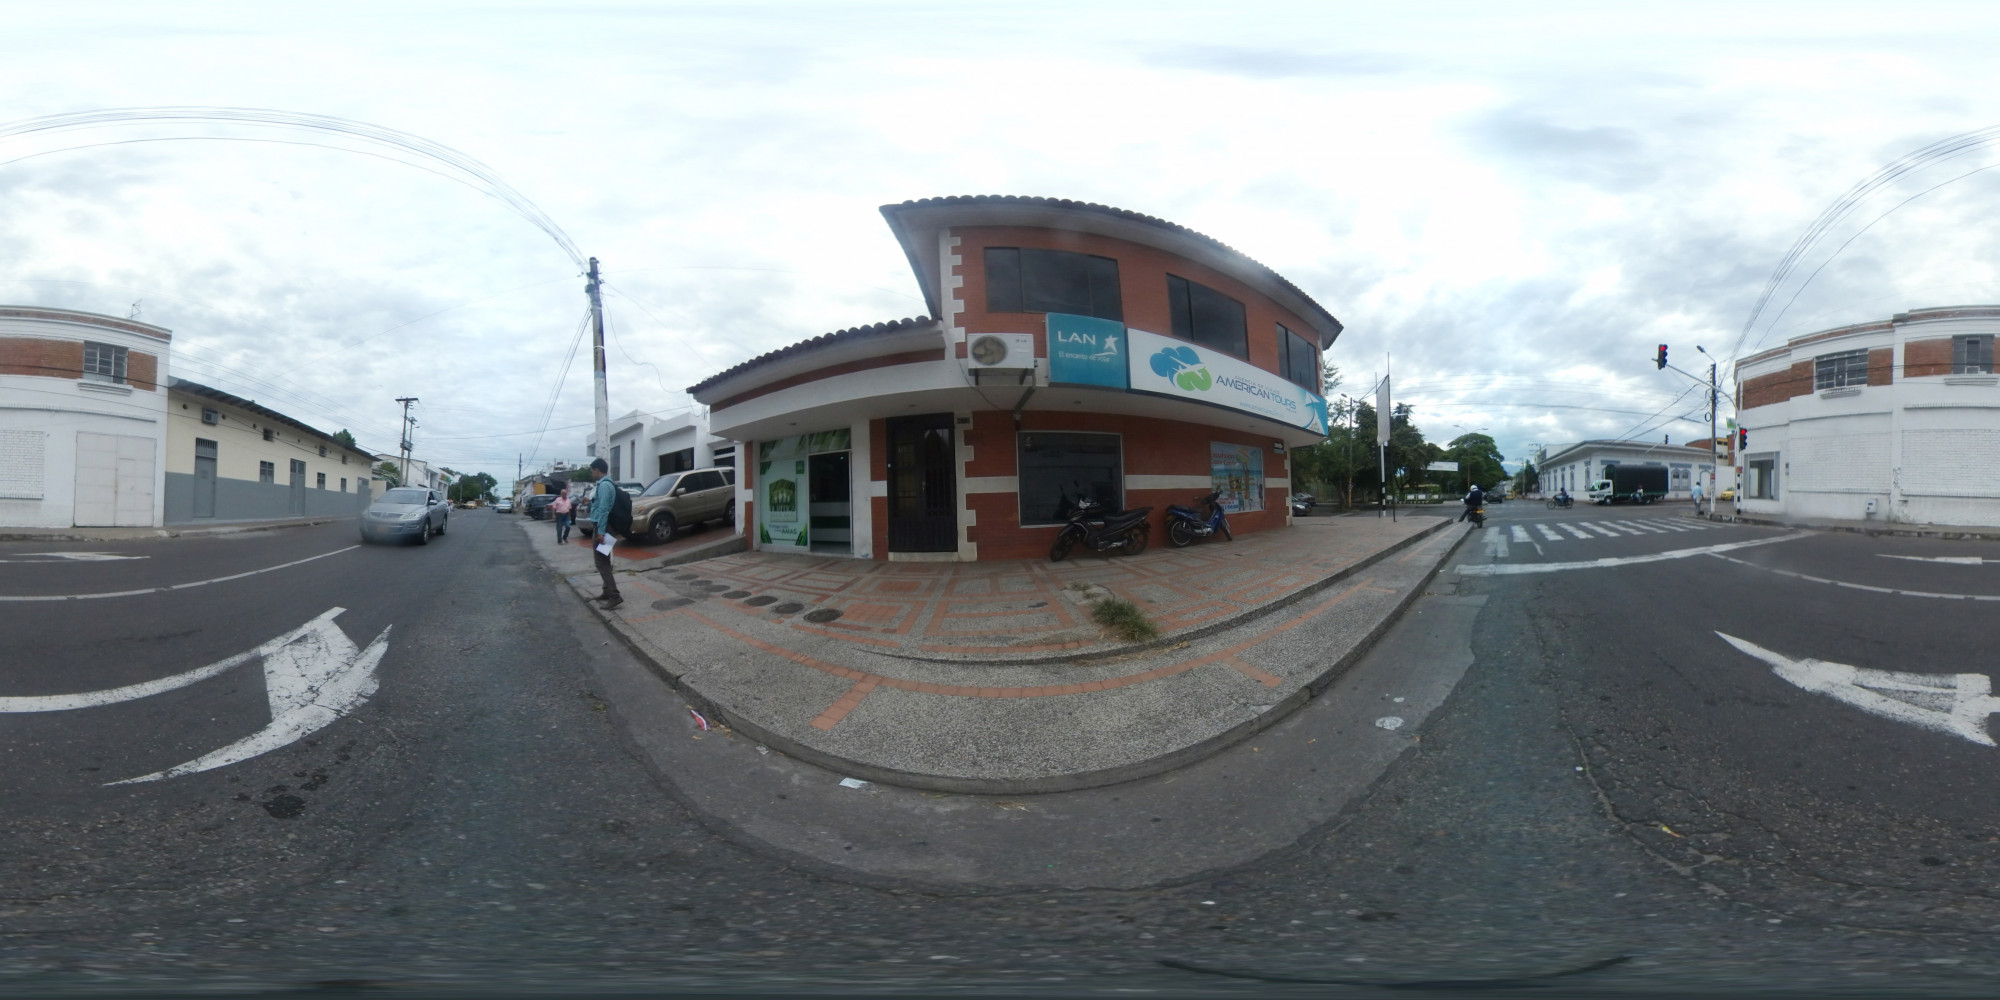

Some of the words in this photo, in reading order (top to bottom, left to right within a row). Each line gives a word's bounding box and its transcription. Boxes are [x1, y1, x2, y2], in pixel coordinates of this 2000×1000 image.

[1058, 330, 1096, 345] LAN
[1216, 375, 1270, 400] AMERICAN
[1271, 392, 1297, 410] TOURS
